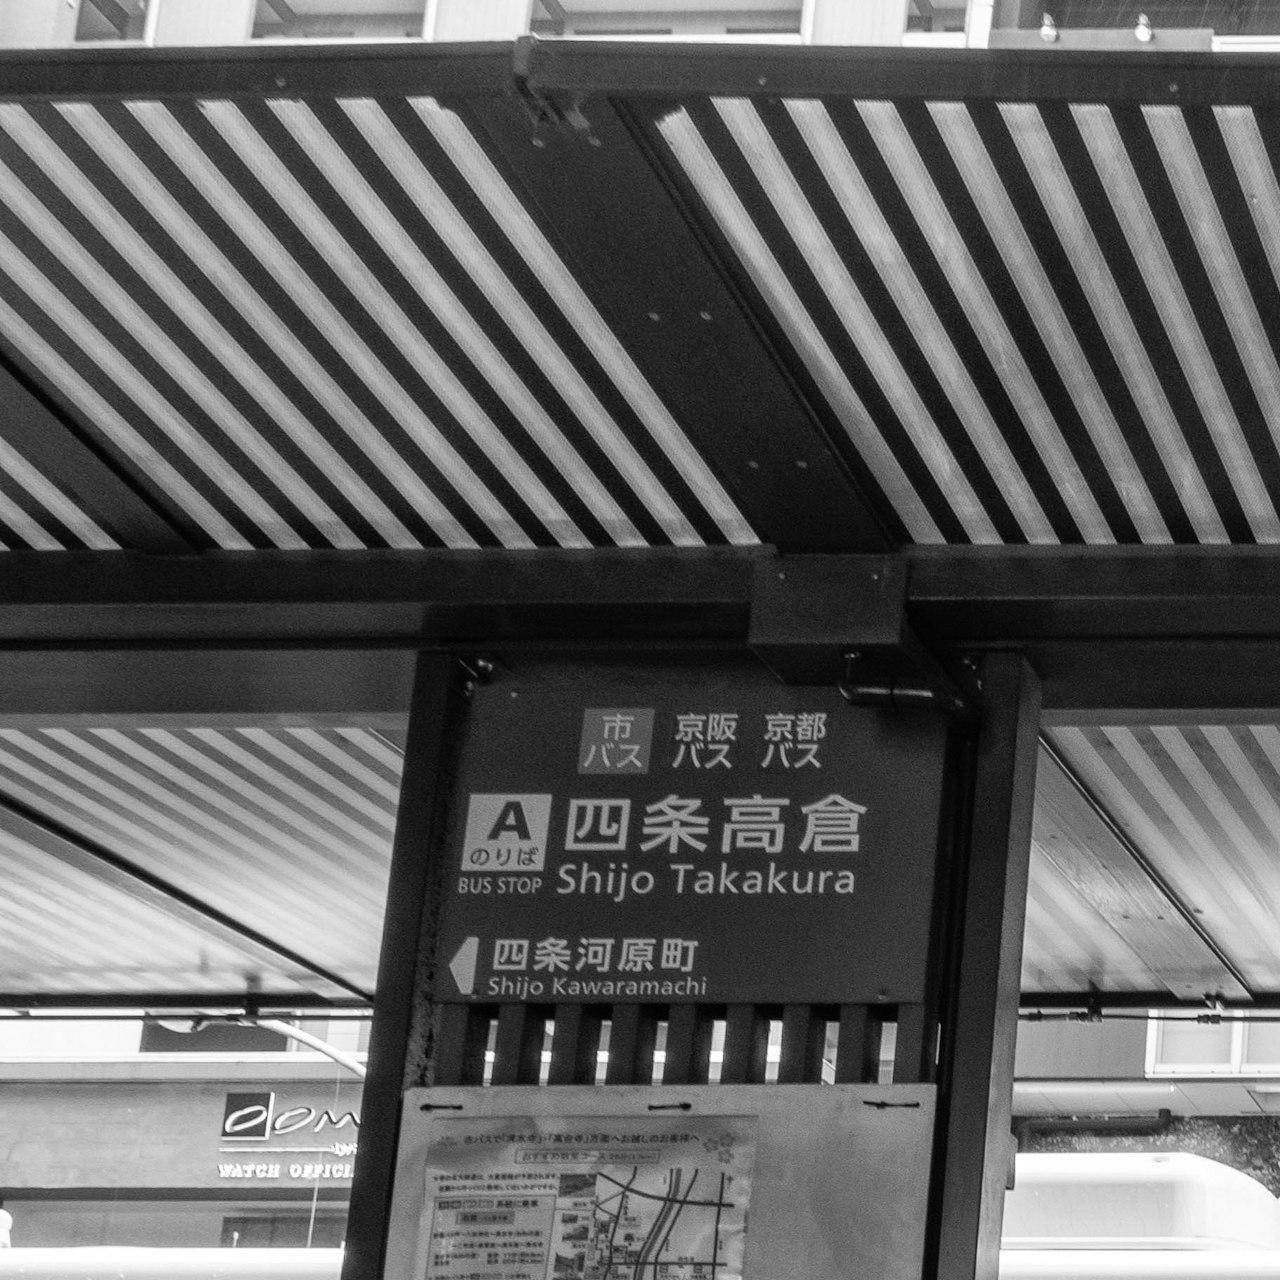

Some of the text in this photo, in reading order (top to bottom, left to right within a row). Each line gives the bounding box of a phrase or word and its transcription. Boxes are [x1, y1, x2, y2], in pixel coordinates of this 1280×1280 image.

[603, 712, 828, 743] 市 京阪 京都
[583, 743, 824, 770] バス バス バス
[487, 801, 532, 842] A
[564, 795, 870, 855] 四条高倉
[469, 846, 540, 868] のりば
[457, 877, 543, 896] BUS STOP
[556, 863, 857, 904] Shijo Takakura
[492, 938, 701, 975] 四条河原町
[487, 976, 708, 999] Shijo Kawaramachi
[217, 1163, 281, 1180] WATCH
